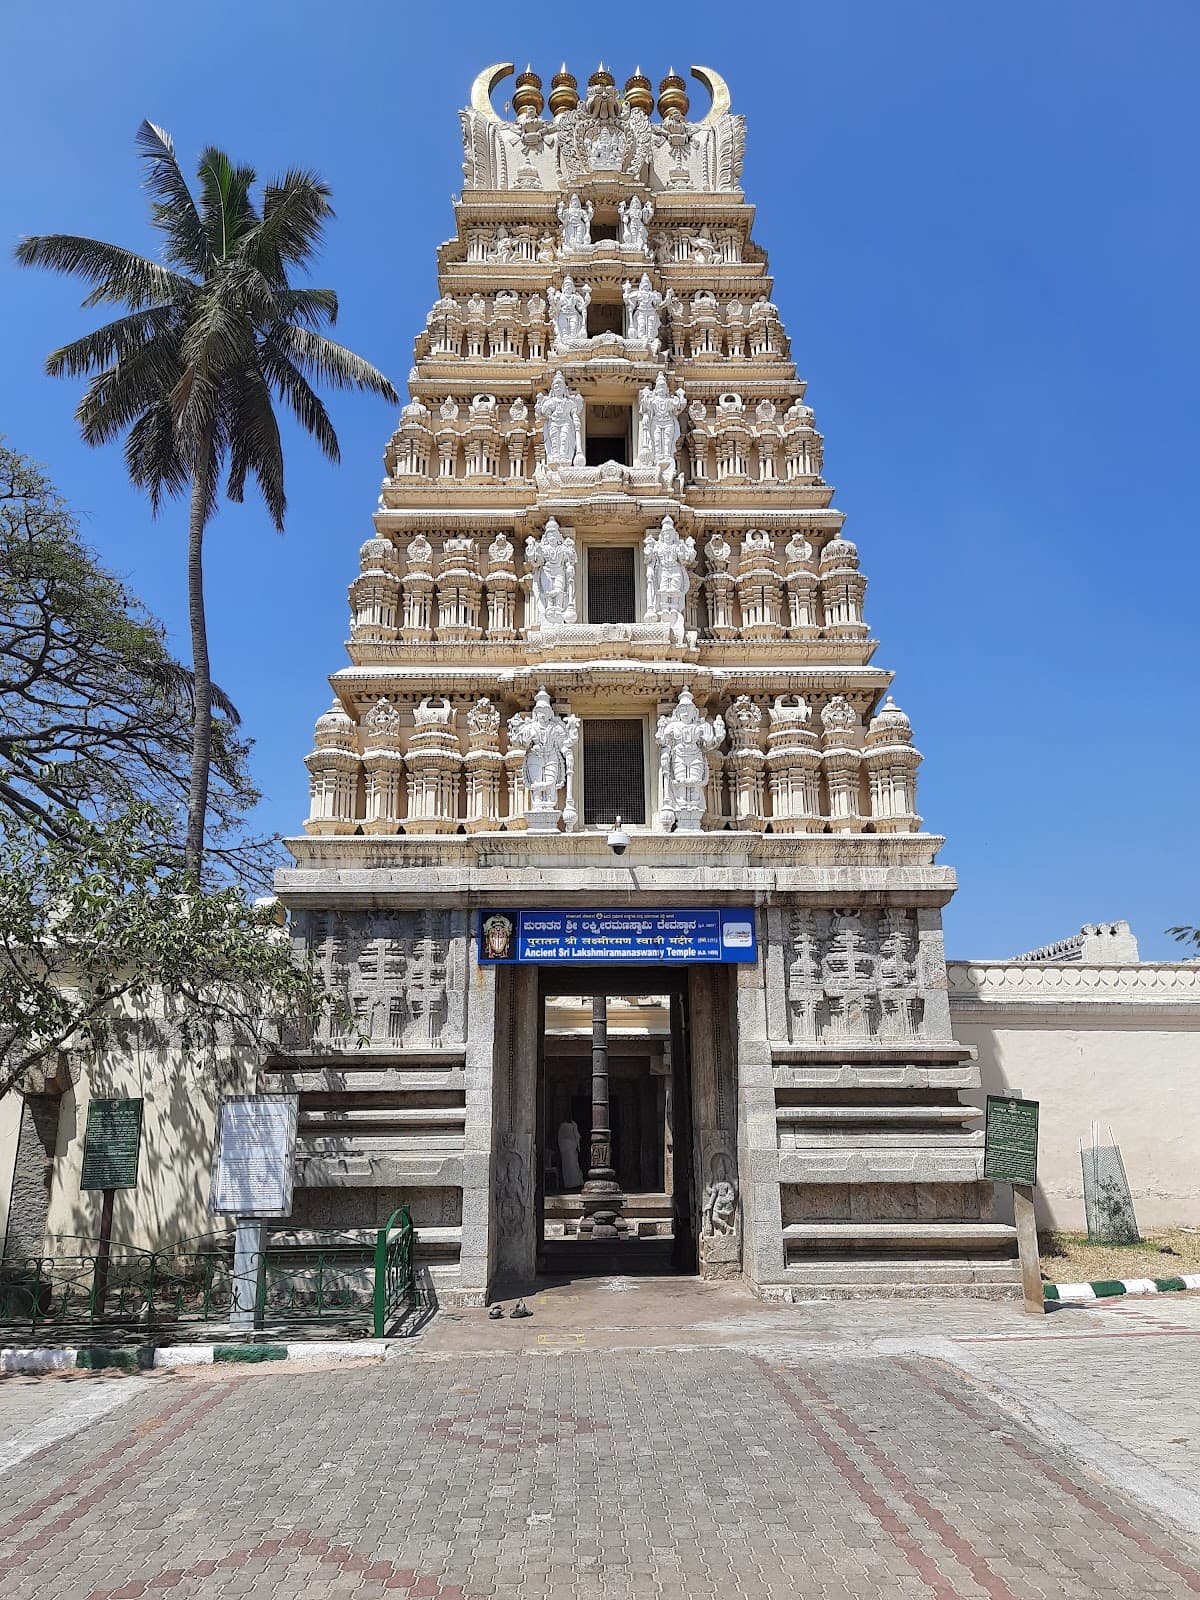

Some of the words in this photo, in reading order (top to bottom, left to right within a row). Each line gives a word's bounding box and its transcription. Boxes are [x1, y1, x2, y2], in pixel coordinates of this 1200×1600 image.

[524, 920, 562, 931] ಪುರಾತನ
[565, 919, 577, 933] ಶ್ರೀ
[527, 937, 560, 947] पुरातन
[565, 936, 577, 944] श्री
[635, 935, 665, 944] स्वामी
[525, 948, 556, 957] Ancient
[558, 948, 570, 957] Sri
[572, 947, 665, 958] Lakshmiramanaswamy
[666, 947, 696, 958] Temple
